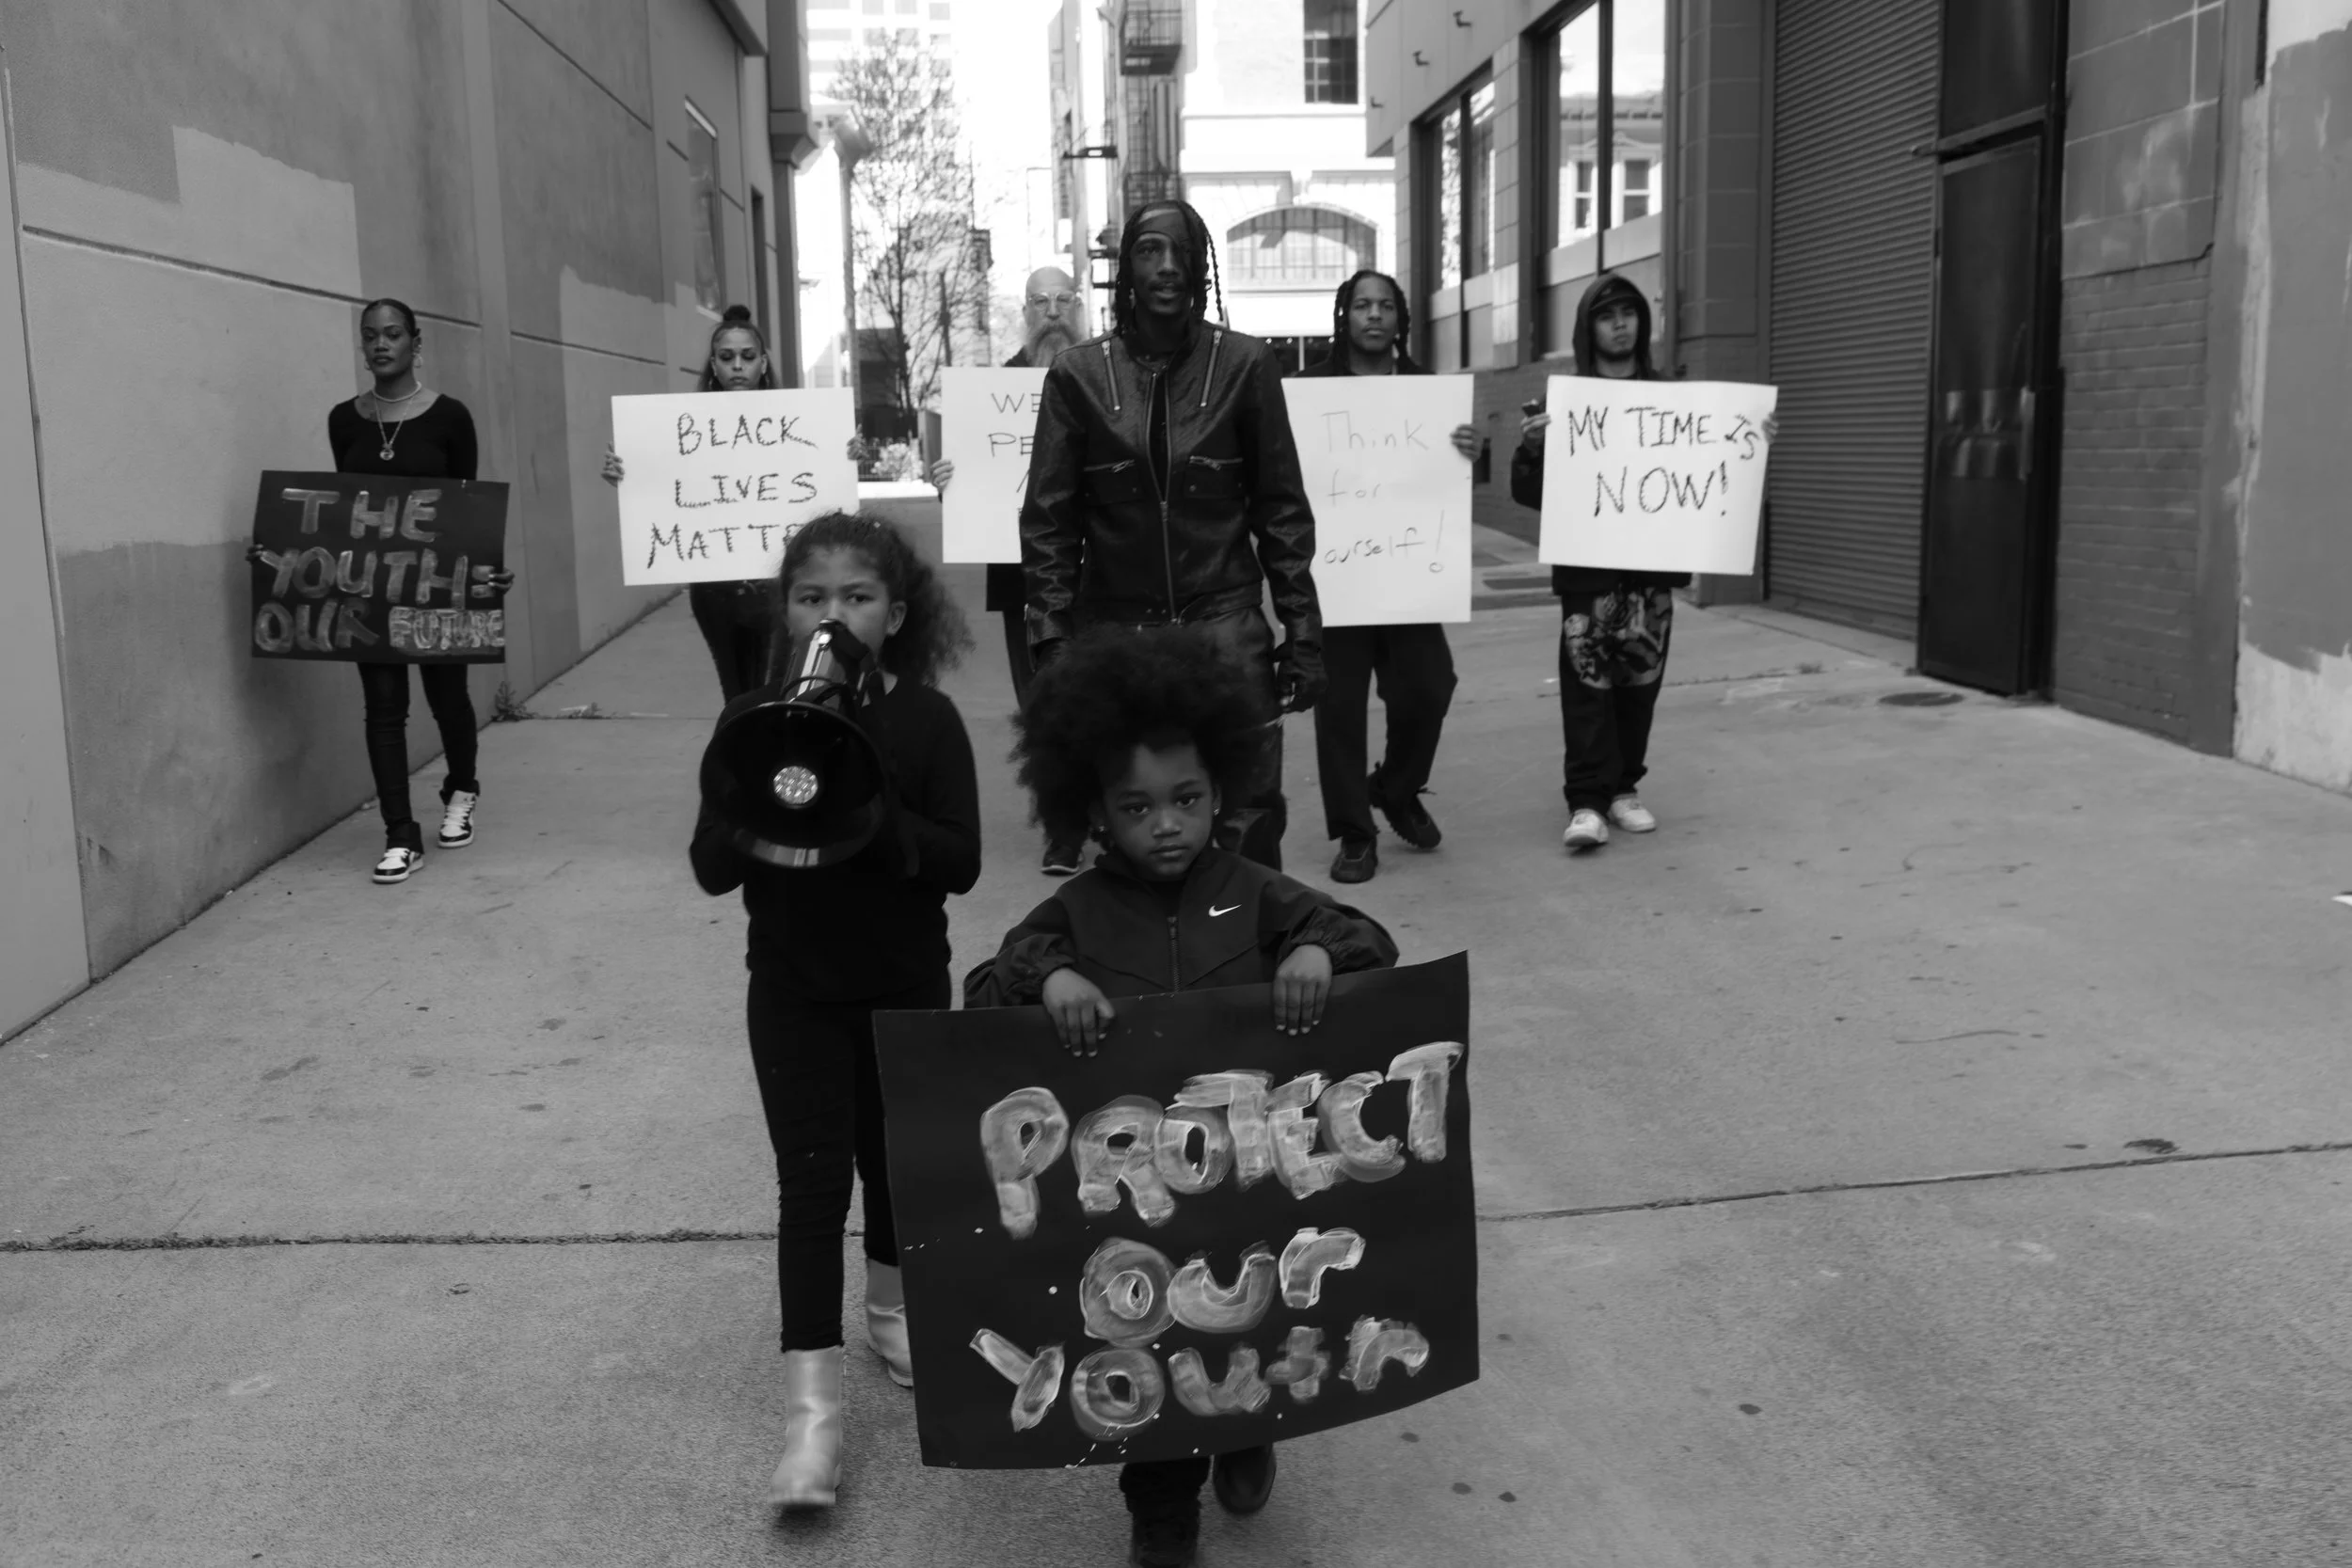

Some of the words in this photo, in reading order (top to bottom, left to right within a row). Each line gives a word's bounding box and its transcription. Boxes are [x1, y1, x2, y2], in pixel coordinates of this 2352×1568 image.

[991, 392, 1042, 413] WE
[677, 412, 818, 456] BLACK
[1321, 410, 1429, 453] Think
[1568, 405, 1609, 457] MY
[1624, 405, 1717, 448] TIME
[675, 472, 818, 508] LIVES
[1328, 468, 1381, 507] for
[1594, 461, 1728, 517] NOW!
[282, 487, 442, 543] THE
[254, 598, 379, 653] OUR
[389, 606, 505, 655] FUTURE
[980, 1041, 1464, 1239] PROTECT
